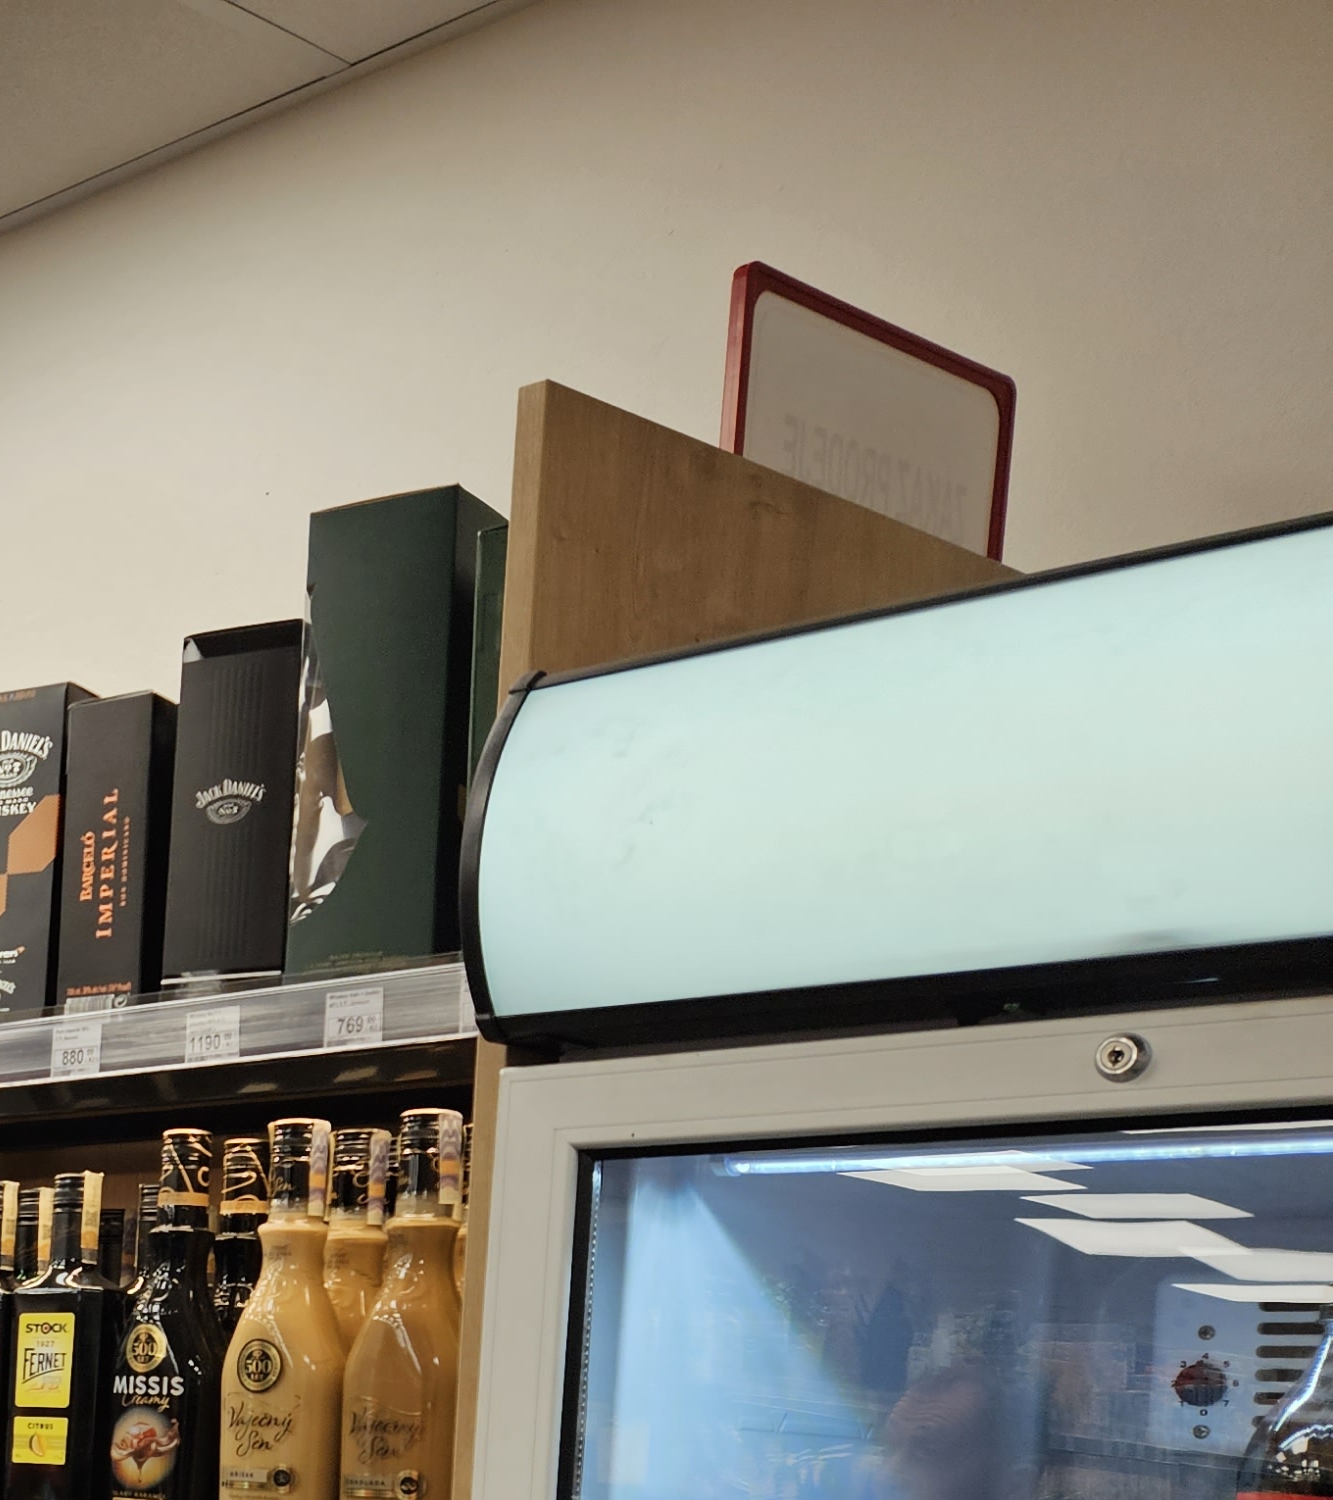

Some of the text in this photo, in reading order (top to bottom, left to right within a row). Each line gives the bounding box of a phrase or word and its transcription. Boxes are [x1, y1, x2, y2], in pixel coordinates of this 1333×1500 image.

[1, 730, 53, 761] DANIEL'S
[79, 831, 96, 902] BARCELÓ
[96, 788, 119, 939] IMPERIAL
[335, 1015, 364, 1035] 769
[188, 1033, 221, 1053] 1190
[244, 1358, 273, 1374] 500
[113, 1375, 184, 1396] MISSIS
